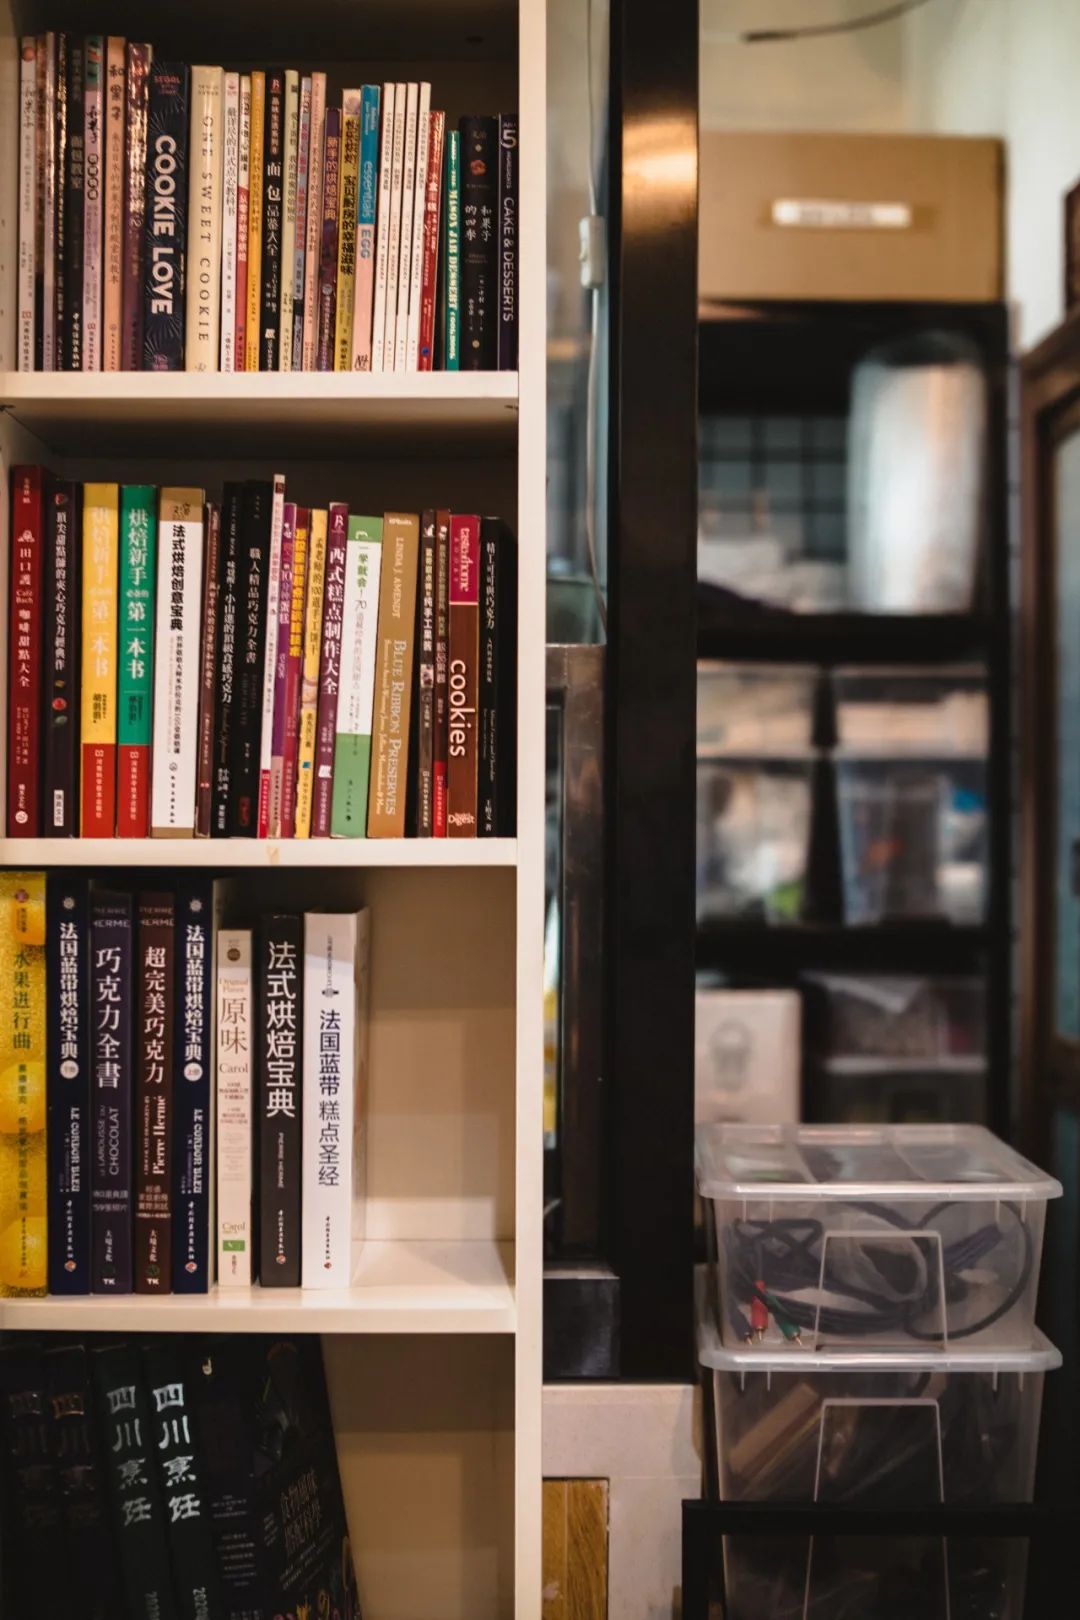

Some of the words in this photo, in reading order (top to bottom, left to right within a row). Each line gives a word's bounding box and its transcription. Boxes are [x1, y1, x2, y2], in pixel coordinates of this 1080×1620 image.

[202, 116, 214, 156] ONE
[500, 128, 517, 150] 5
[153, 134, 177, 236] COOKIE
[200, 172, 213, 242] SWEET
[448, 190, 459, 228] MASON
[360, 228, 372, 259] EGG
[448, 229, 459, 254] JAR
[502, 196, 515, 238] CAKE
[503, 239, 514, 249] &
[151, 247, 174, 315] LOVE
[198, 257, 211, 341] COOKIE
[448, 255, 458, 311] DESSERT
[502, 251, 514, 322] DESSERTS
[127, 508, 149, 586] 烘焙新手
[394, 537, 405, 567] LINDA
[322, 547, 346, 695] 西式糕点制作大全
[391, 576, 402, 618] AMENDT
[126, 601, 147, 680] 第一本书
[392, 639, 407, 677] BLUE
[389, 681, 405, 734] RIBBON
[449, 659, 476, 757] cookies
[385, 738, 402, 815] PRESERVES
[12, 948, 31, 1050] 水果进行曲
[59, 922, 79, 1060] 法国蓝带烘焙宝典
[95, 946, 122, 1088] 巧克力全書
[143, 945, 167, 1084] 超完美巧克力
[184, 924, 205, 1062] 法国蓝带烘焙宝典
[219, 996, 248, 1055] 原味
[266, 940, 297, 1118] 法式烘焙宝典
[319, 1009, 341, 1097] 法国蓝带
[218, 1061, 249, 1075] Carol
[71, 1107, 80, 1119] LE
[108, 1106, 120, 1176] CHOCOLAT
[152, 1095, 167, 1136] Hermé
[193, 1108, 203, 1121] LE
[152, 1138, 166, 1175] Pierre
[318, 1101, 341, 1187] 糕点圣经
[70, 1166, 81, 1192] BLEU
[193, 1167, 203, 1194] BLEU
[102, 1277, 116, 1285] TK
[146, 1277, 160, 1286] TK
[106, 1385, 152, 1527] 四川烹饪
[152, 1383, 201, 1523] 四川烹饪
